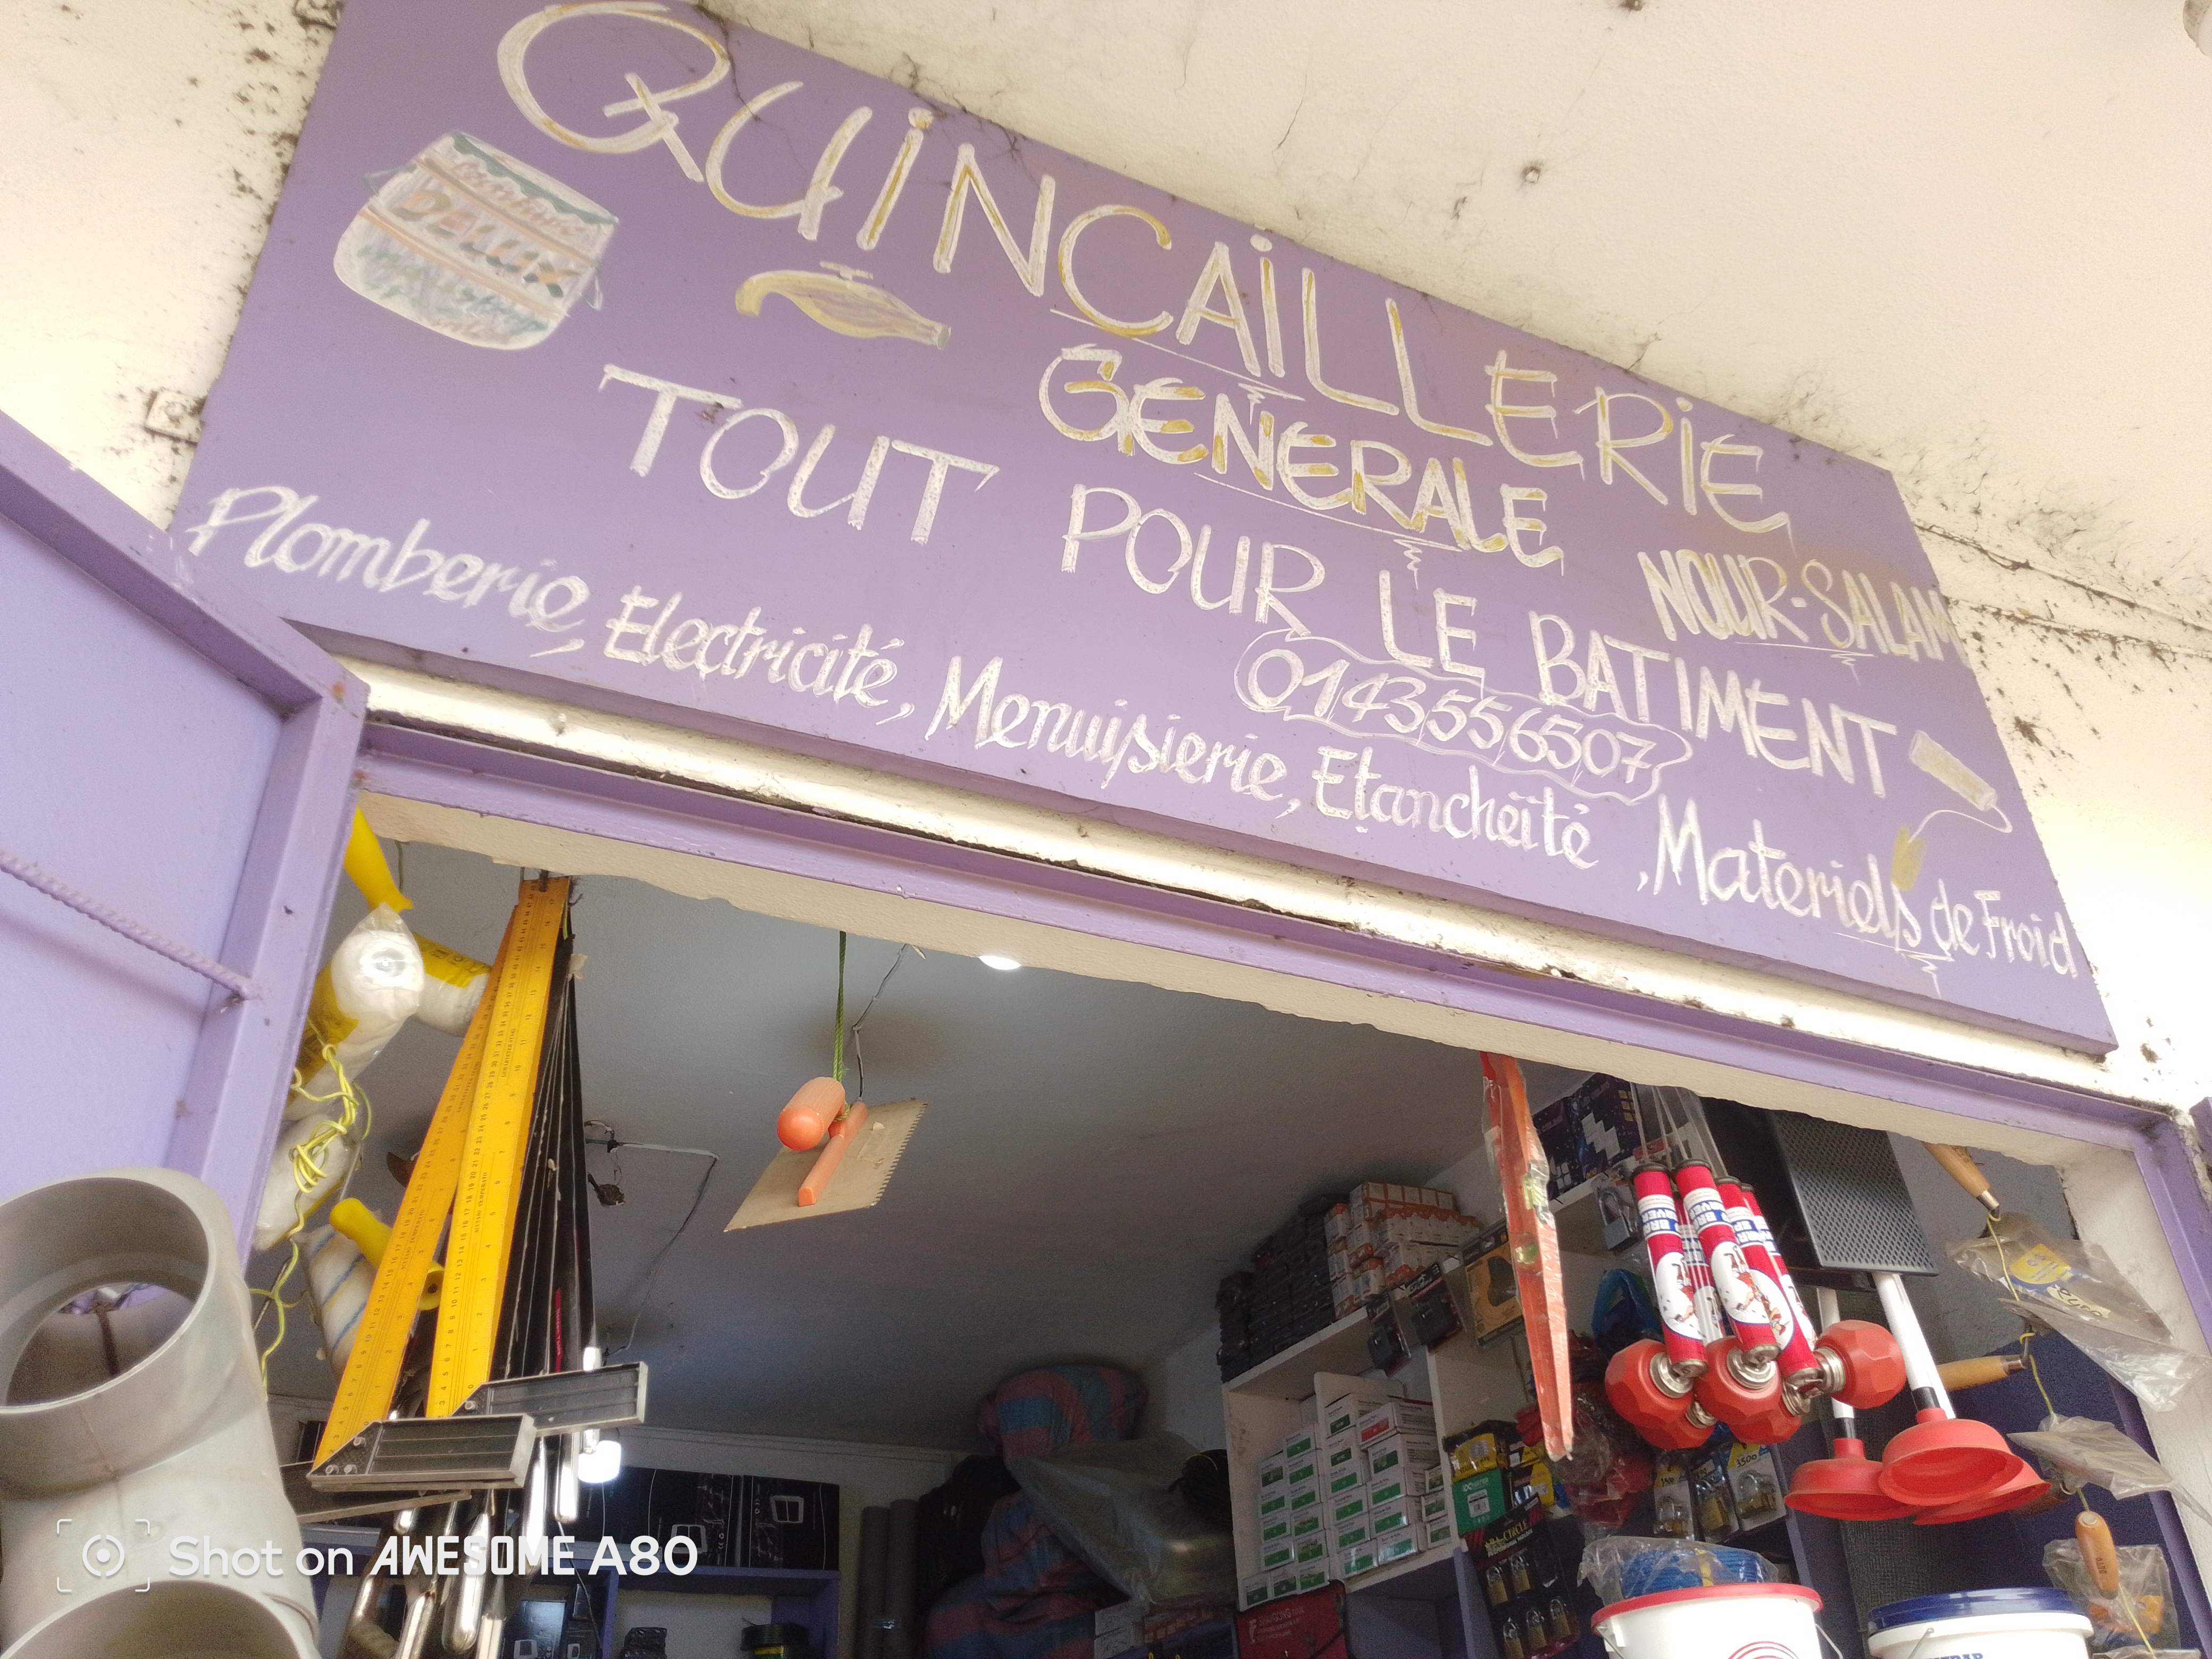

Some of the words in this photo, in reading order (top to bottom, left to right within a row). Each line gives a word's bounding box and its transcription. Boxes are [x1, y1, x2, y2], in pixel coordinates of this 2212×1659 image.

[497, 2, 1793, 553] QUINCAILLERIE
[1038, 343, 1564, 573] GENERALE
[598, 362, 1000, 546] TOUT
[1061, 484, 1325, 638] POUR
[1379, 569, 1485, 698] LE
[1528, 610, 1897, 798] BATIMENT
[1247, 648, 1656, 784] 0143556507
[1930, 878, 1980, 957] de
[1974, 890, 2078, 978] Froid
